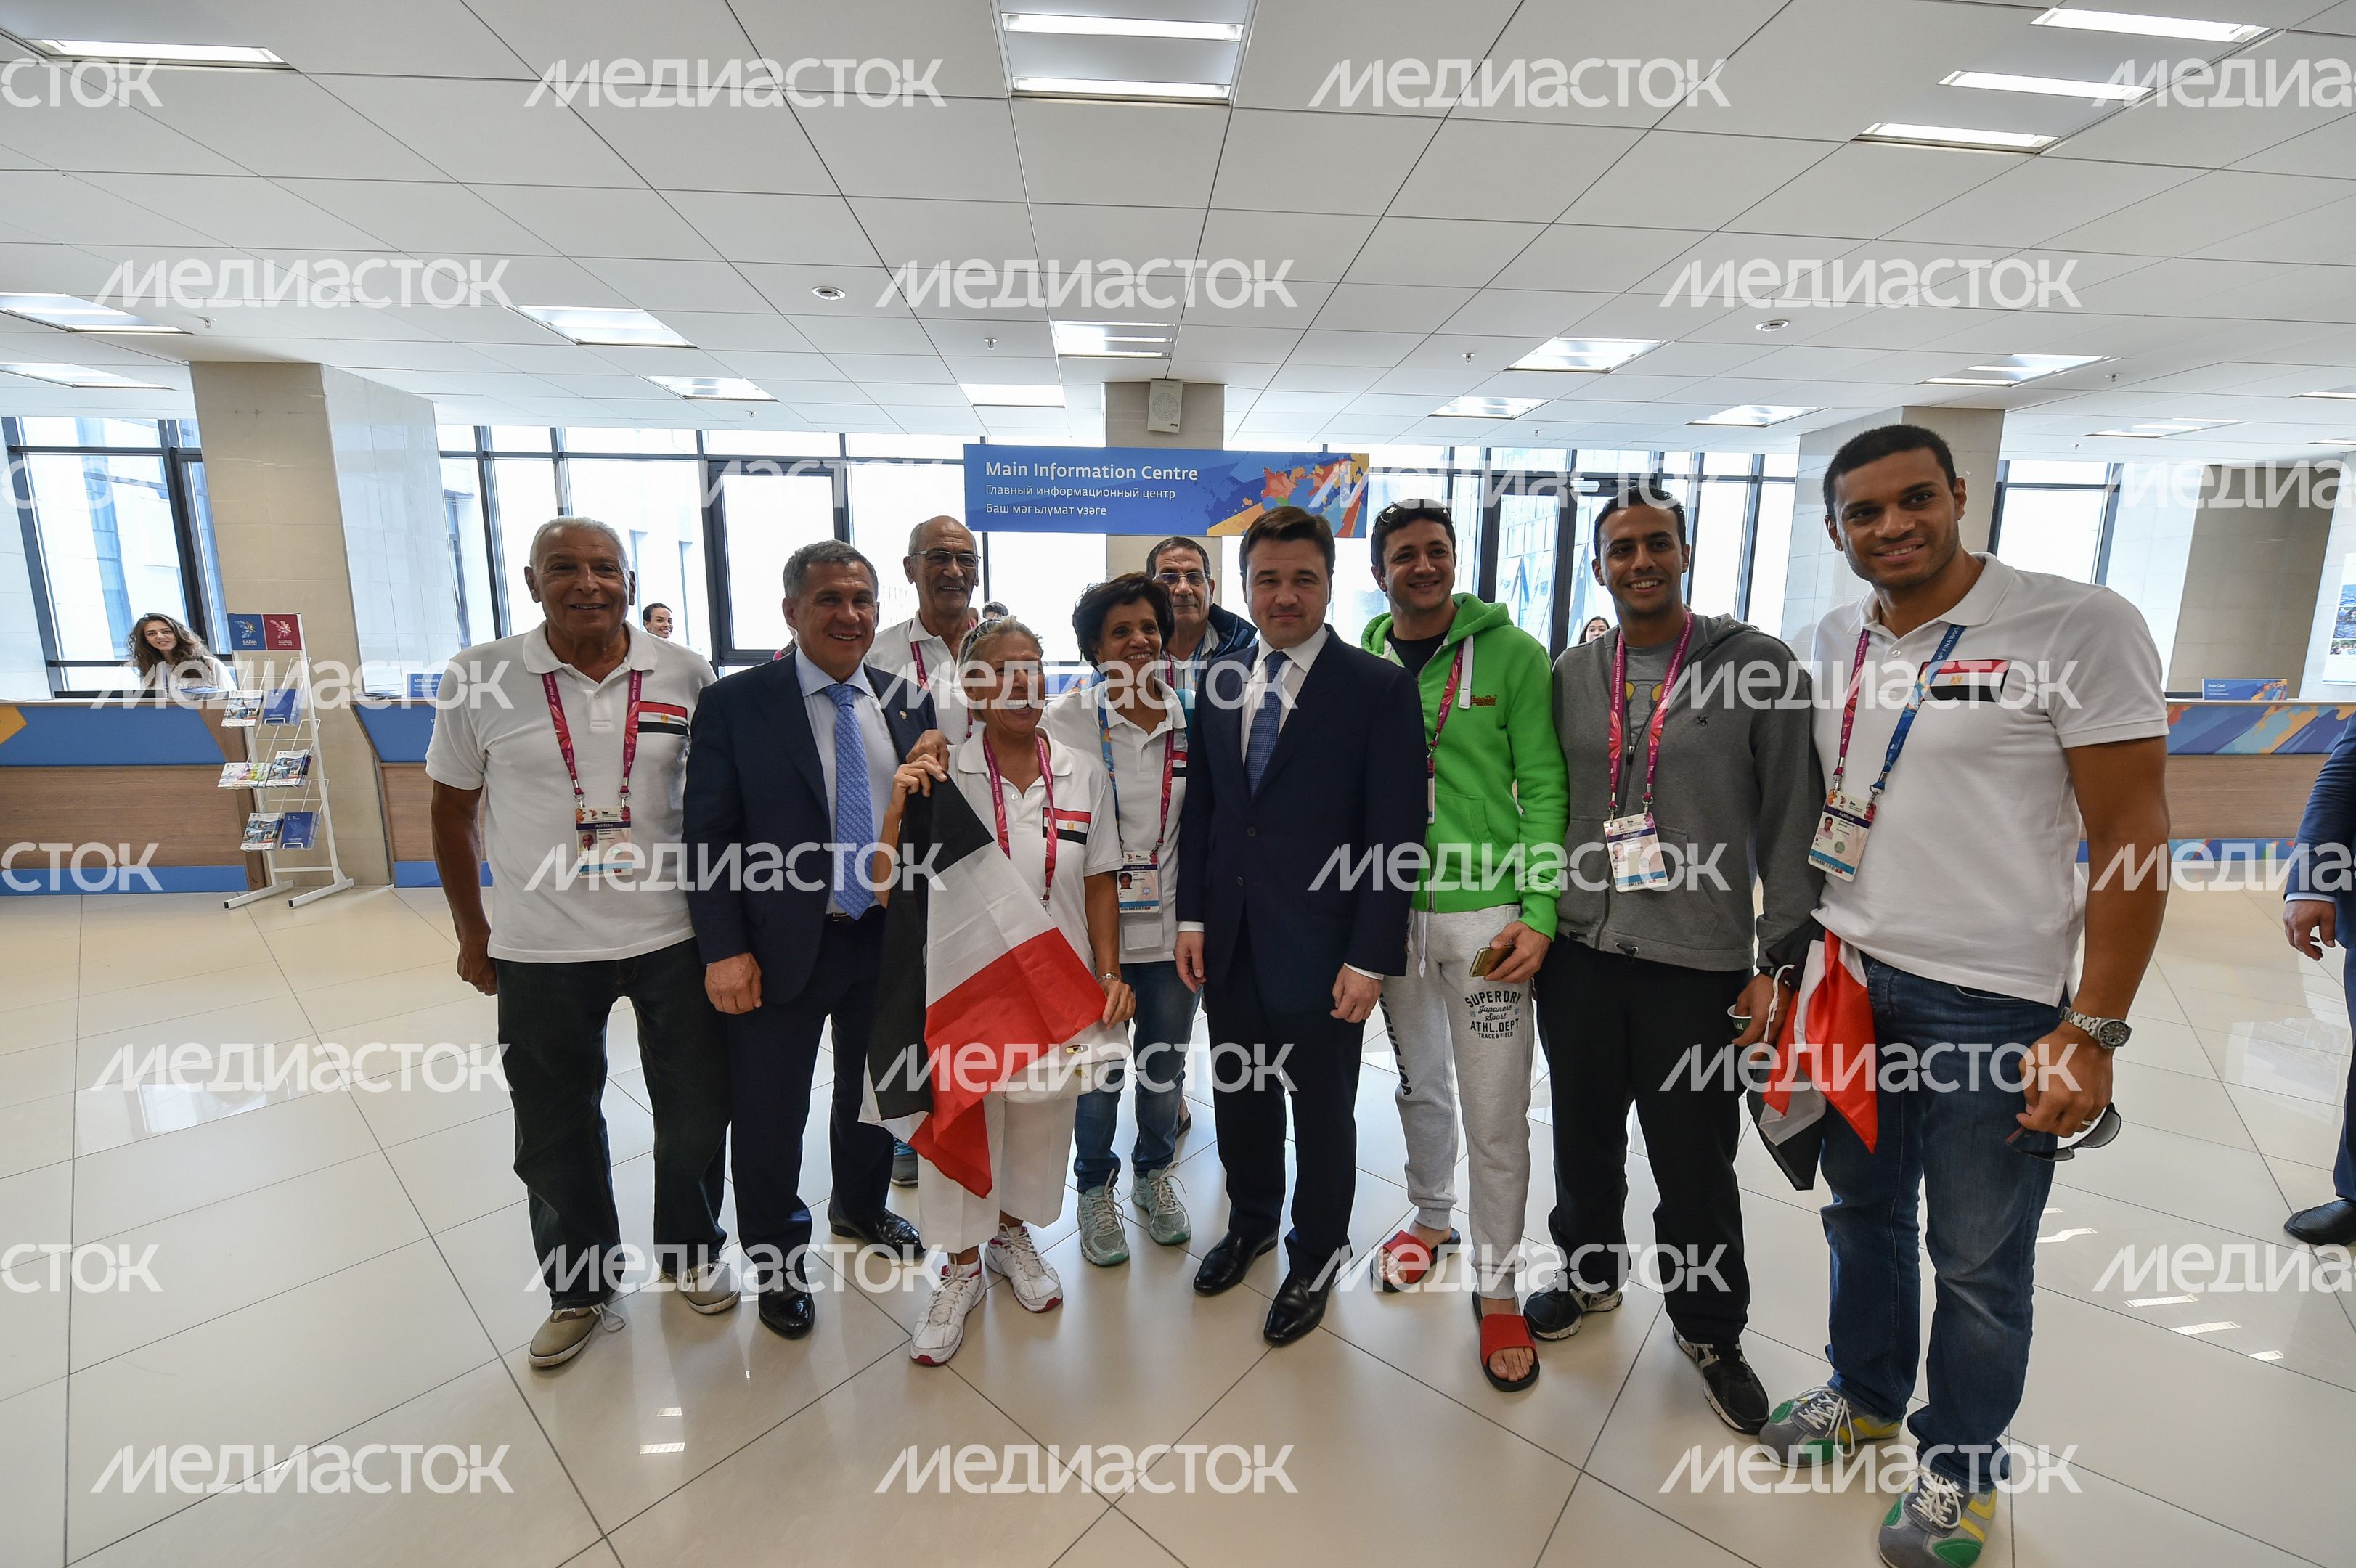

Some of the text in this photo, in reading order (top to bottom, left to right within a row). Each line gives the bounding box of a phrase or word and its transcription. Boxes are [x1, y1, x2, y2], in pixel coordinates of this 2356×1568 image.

[985, 461, 1199, 481] Main Information Centre
[985, 485, 1175, 501] Главный информационный центр
[985, 503, 1009, 513] Баш
[1941, 638, 1952, 652] FINA
[1464, 991, 1523, 1008] SUPERDRY
[1485, 1013, 1507, 1021] Sport
